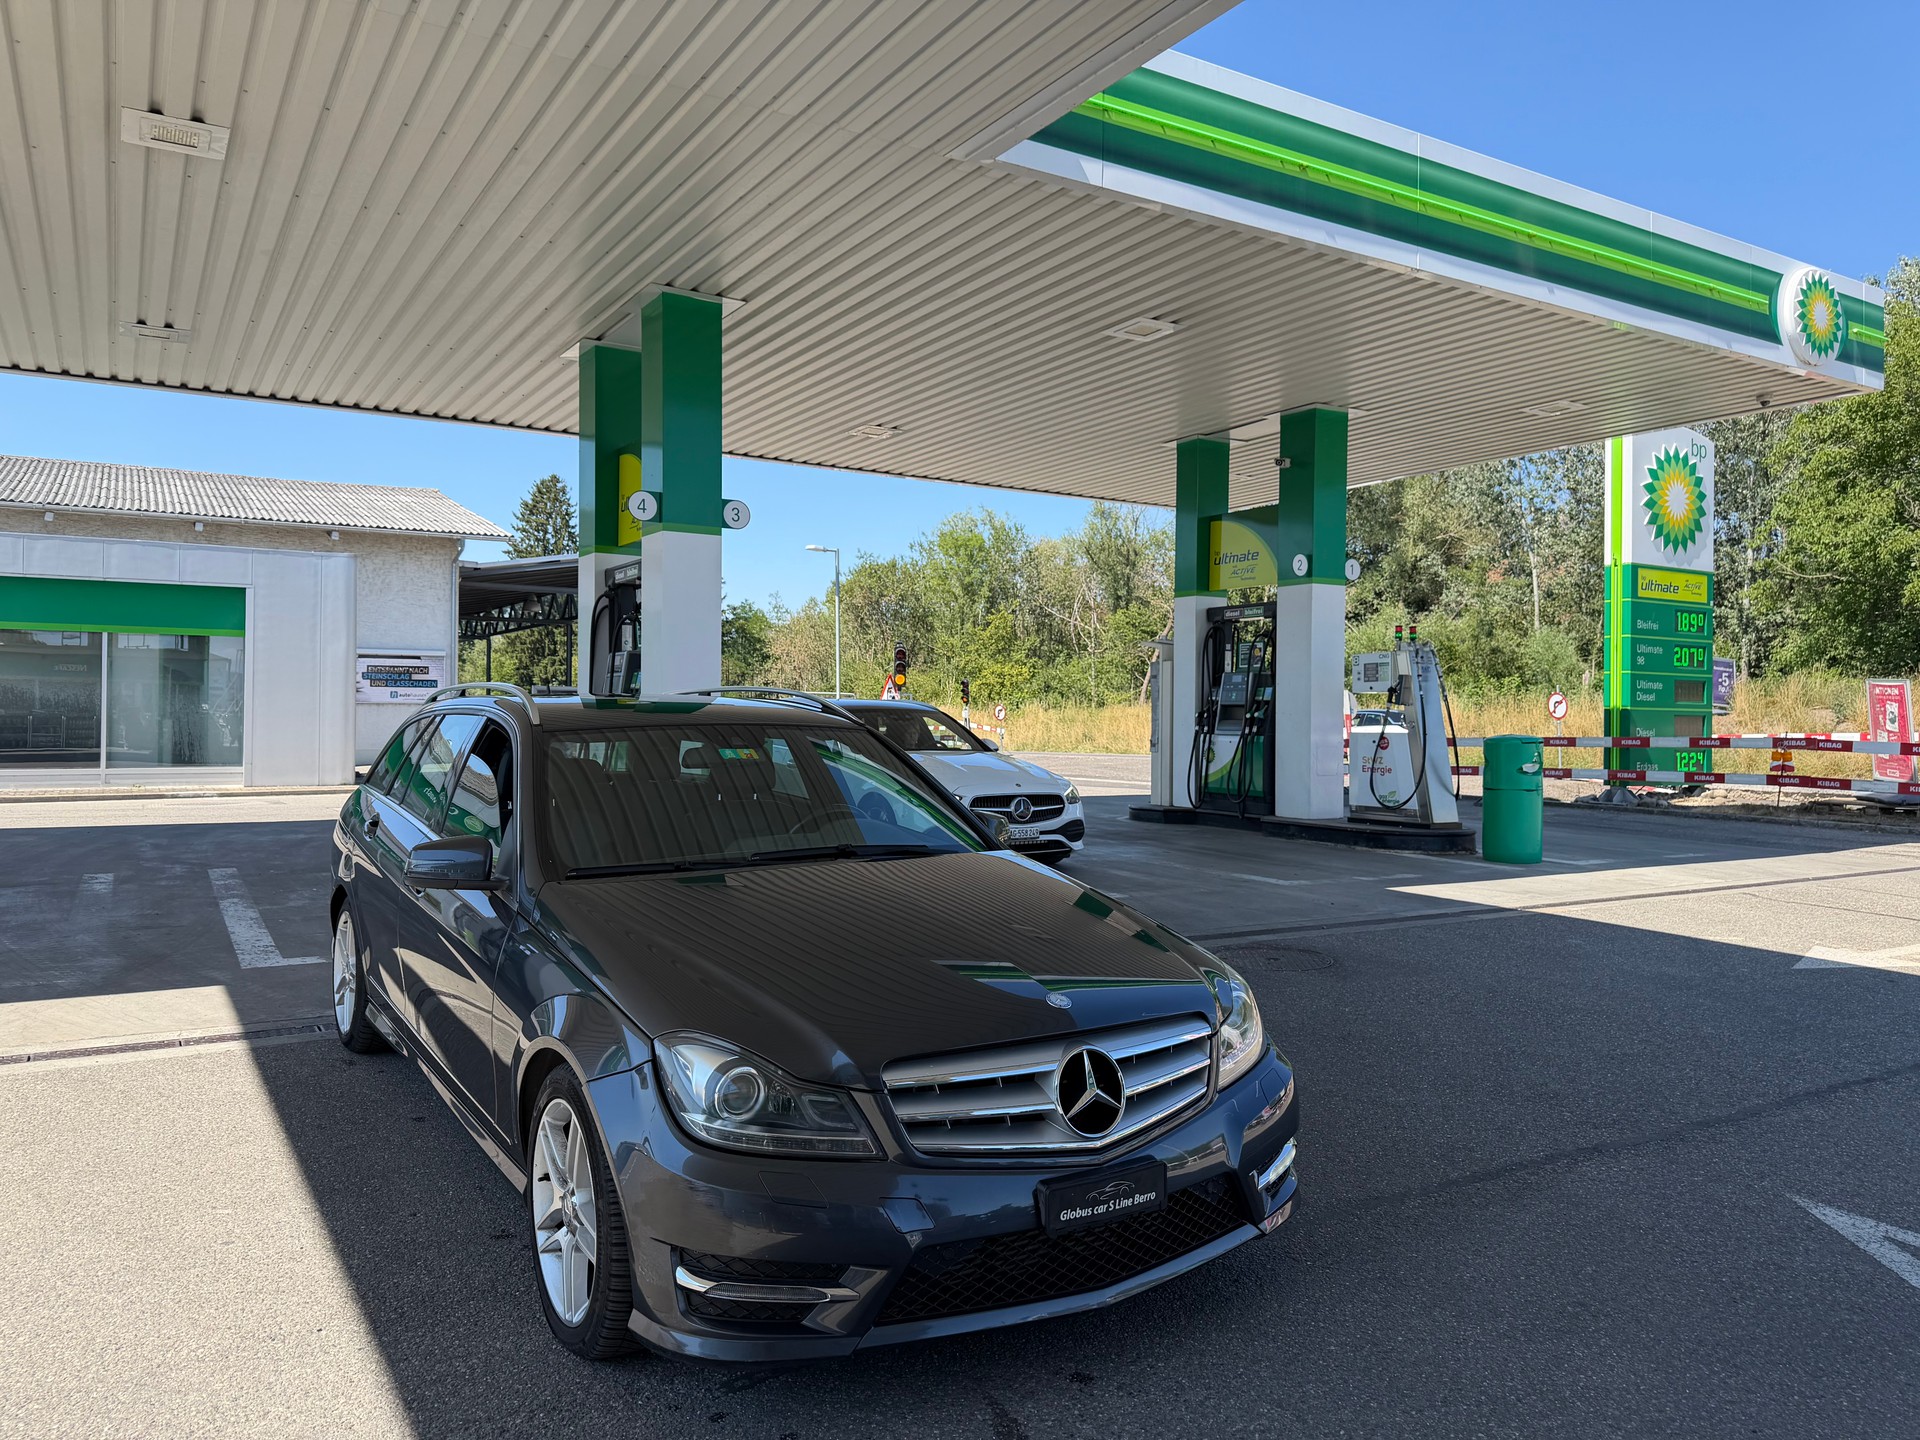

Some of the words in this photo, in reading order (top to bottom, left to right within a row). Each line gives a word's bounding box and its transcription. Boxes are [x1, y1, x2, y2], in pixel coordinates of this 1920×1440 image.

[1691, 438, 1706, 463] bp
[637, 499, 647, 513] 4
[731, 508, 740, 522] 3
[1214, 549, 1259, 566] ultimate
[1230, 566, 1255, 576] ACTIVE
[1298, 560, 1303, 571] 2
[1350, 564, 1354, 575] 1
[1641, 580, 1679, 594] ultimate
[1637, 619, 1659, 631] Bleifrei
[1636, 644, 1663, 655] Ultimate
[1636, 656, 1645, 666] 98
[1636, 680, 1663, 690] Ultimate
[1636, 691, 1656, 701] Diesel
[1636, 727, 1656, 737] Diesel
[1819, 741, 1842, 749] KIBAG
[1362, 765, 1393, 776] Energie
[1694, 774, 1715, 782] KIBAG
[1060, 1207, 1092, 1221] Globus
[1093, 1202, 1108, 1215] car
[1108, 1200, 1115, 1212] S
[1115, 1194, 1133, 1210] Line
[1133, 1191, 1156, 1205] Berro
